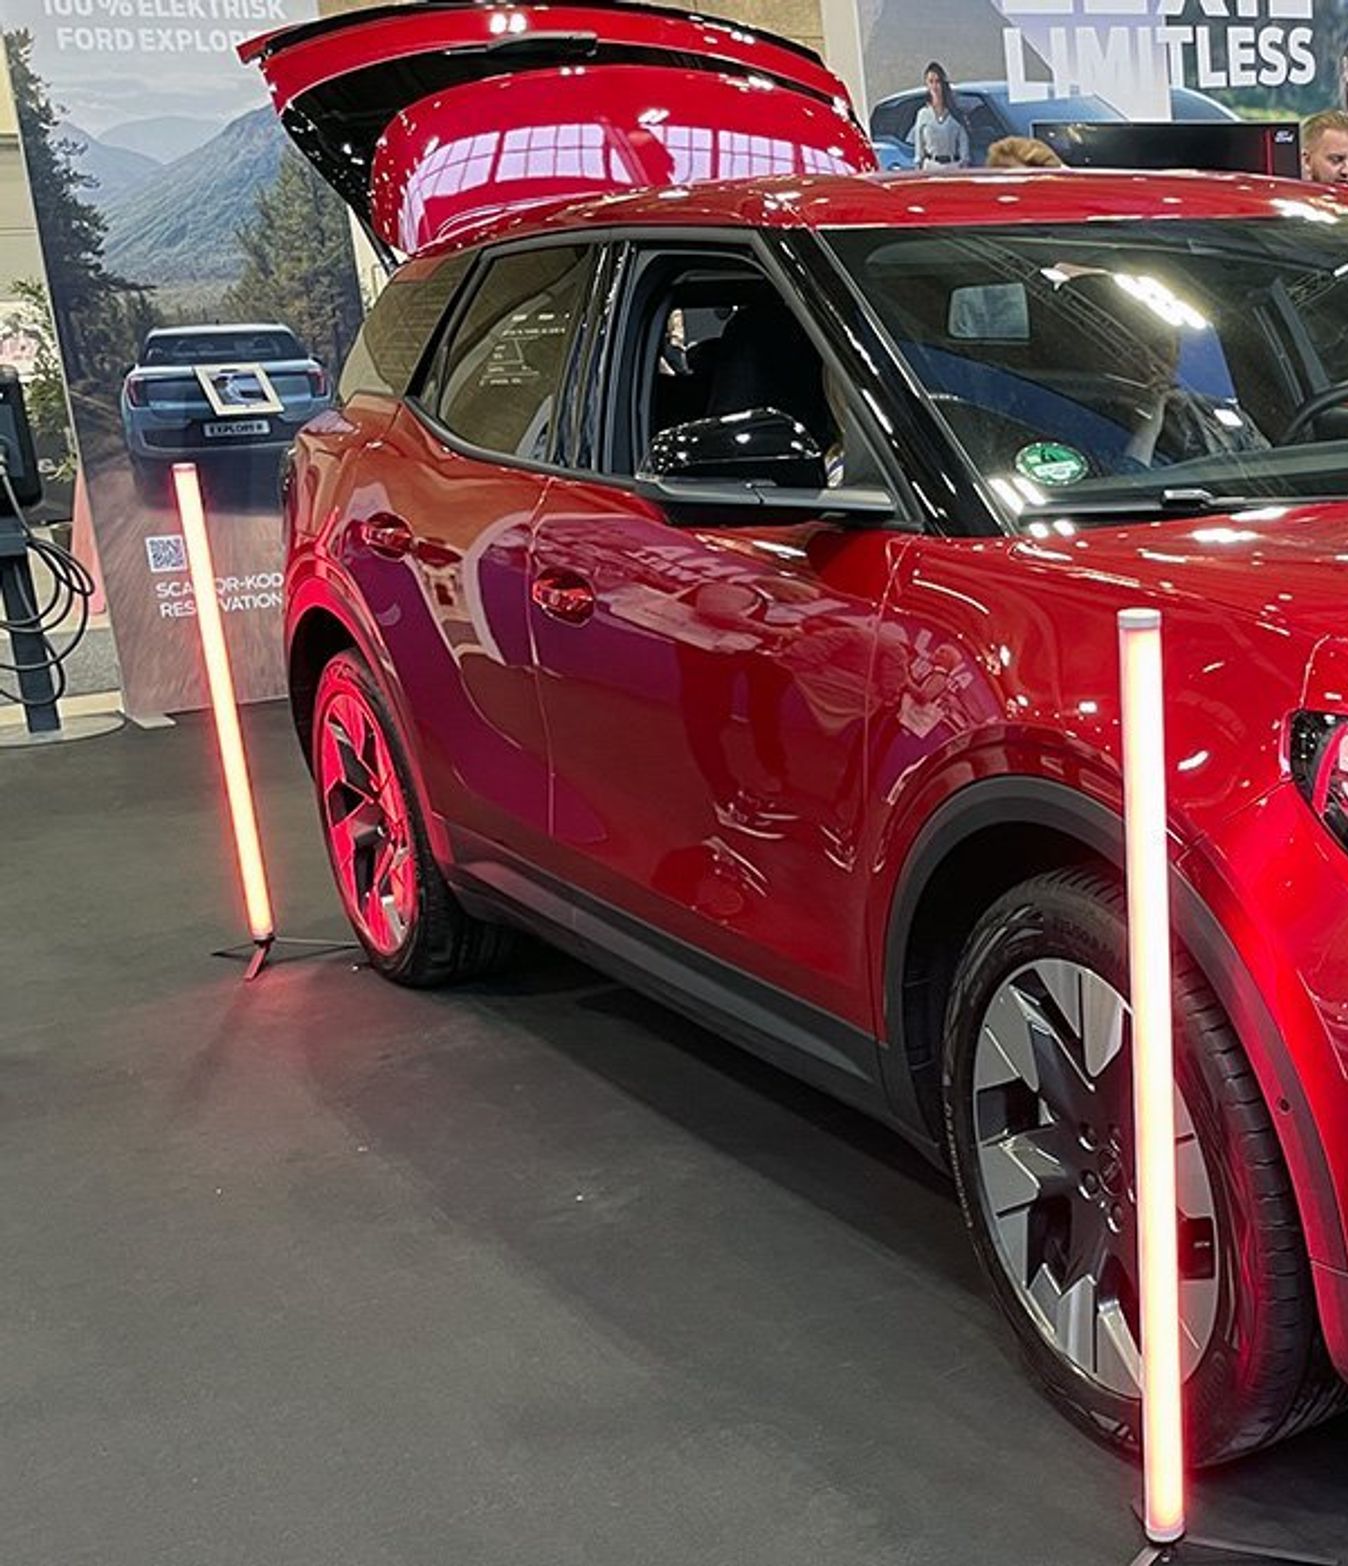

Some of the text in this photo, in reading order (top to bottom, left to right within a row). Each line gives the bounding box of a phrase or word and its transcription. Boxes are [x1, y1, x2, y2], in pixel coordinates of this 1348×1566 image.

[138, 0, 287, 19] ELEKTRISK
[57, 27, 135, 51] FORD
[1003, 26, 1316, 104] LIMITLESS
[156, 572, 284, 599] SCA QR-KOD
[159, 592, 283, 618] RESVATION
